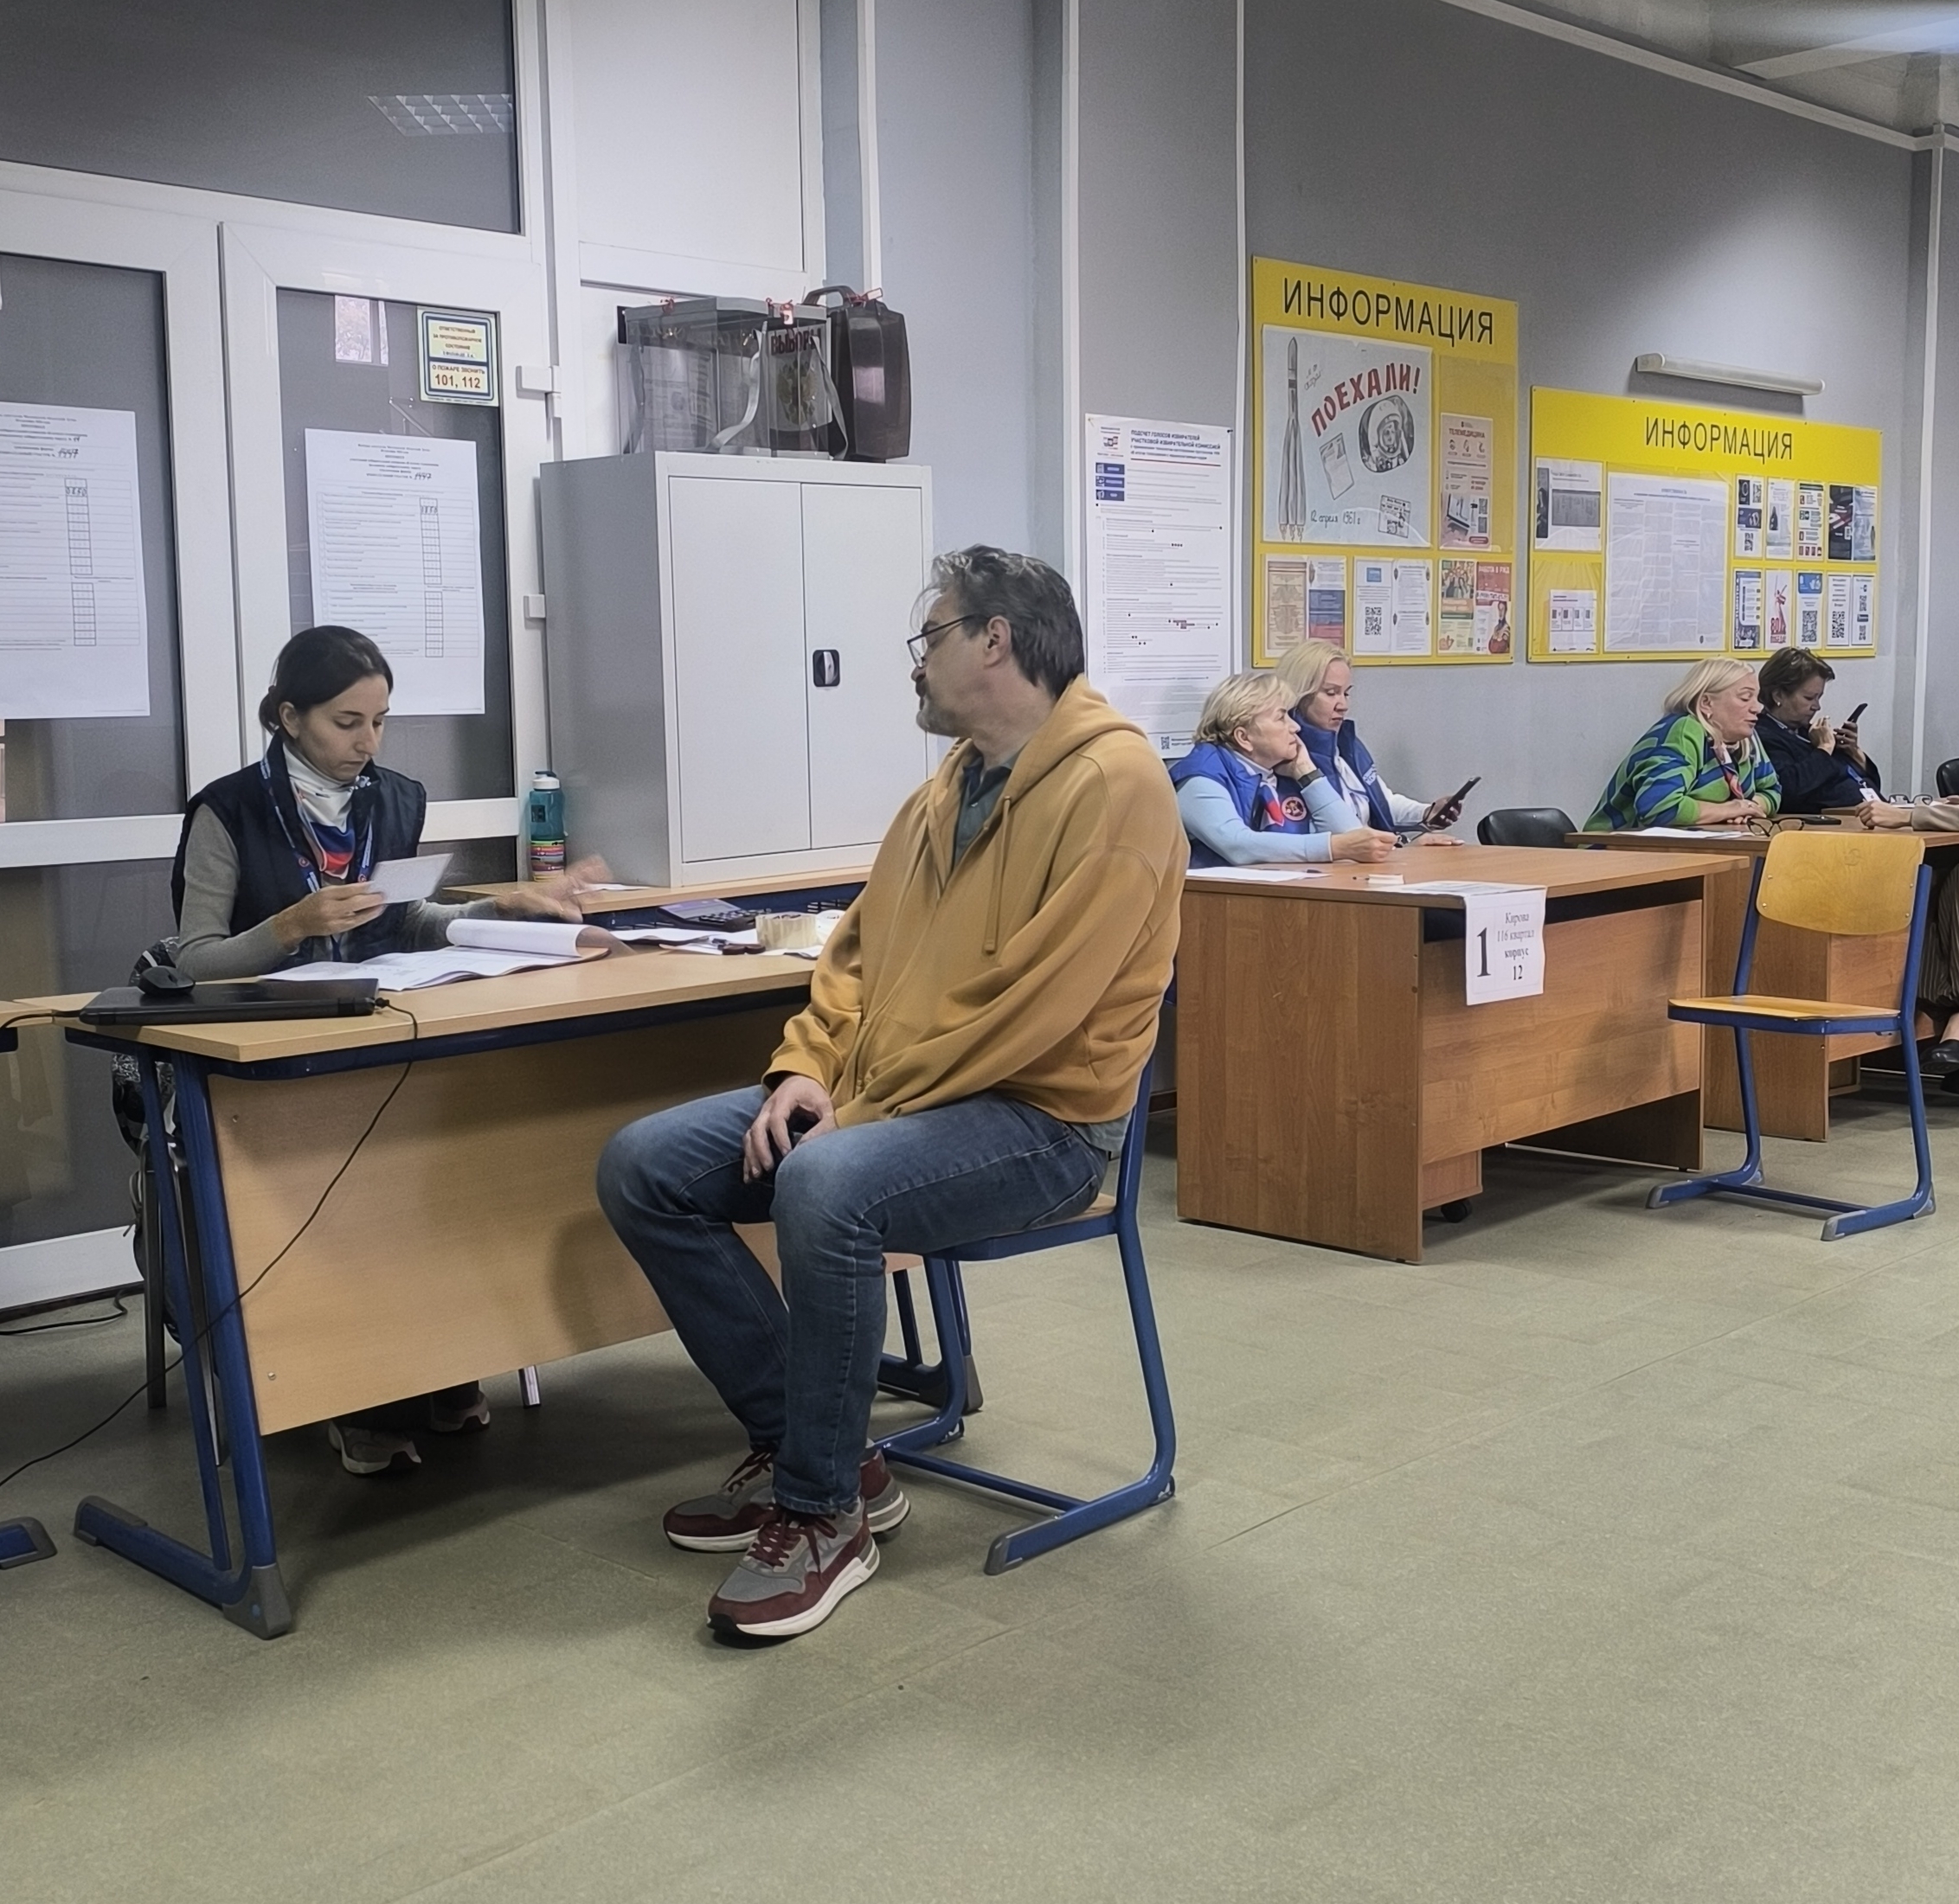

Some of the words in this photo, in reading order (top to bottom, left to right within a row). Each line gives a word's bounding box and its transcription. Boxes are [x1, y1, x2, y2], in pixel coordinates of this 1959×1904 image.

[1284, 277, 1493, 348] ИНФОРМАЦИЯ
[437, 364, 459, 373] ПОЖАРЕ
[461, 366, 485, 375] ЗВОНИТЬ
[435, 374, 459, 388] 101,
[462, 376, 481, 389] 112
[1311, 362, 1421, 437] ПОЕХАЛИ!
[1646, 416, 1793, 465] ИНФОРМАЦИЯ
[1506, 912, 1529, 926] Кирова
[1497, 930, 1508, 942] 116
[1510, 929, 1534, 942] квартал
[1477, 926, 1492, 978] 1
[1504, 947, 1529, 960] корпус
[1513, 965, 1523, 980] 12
